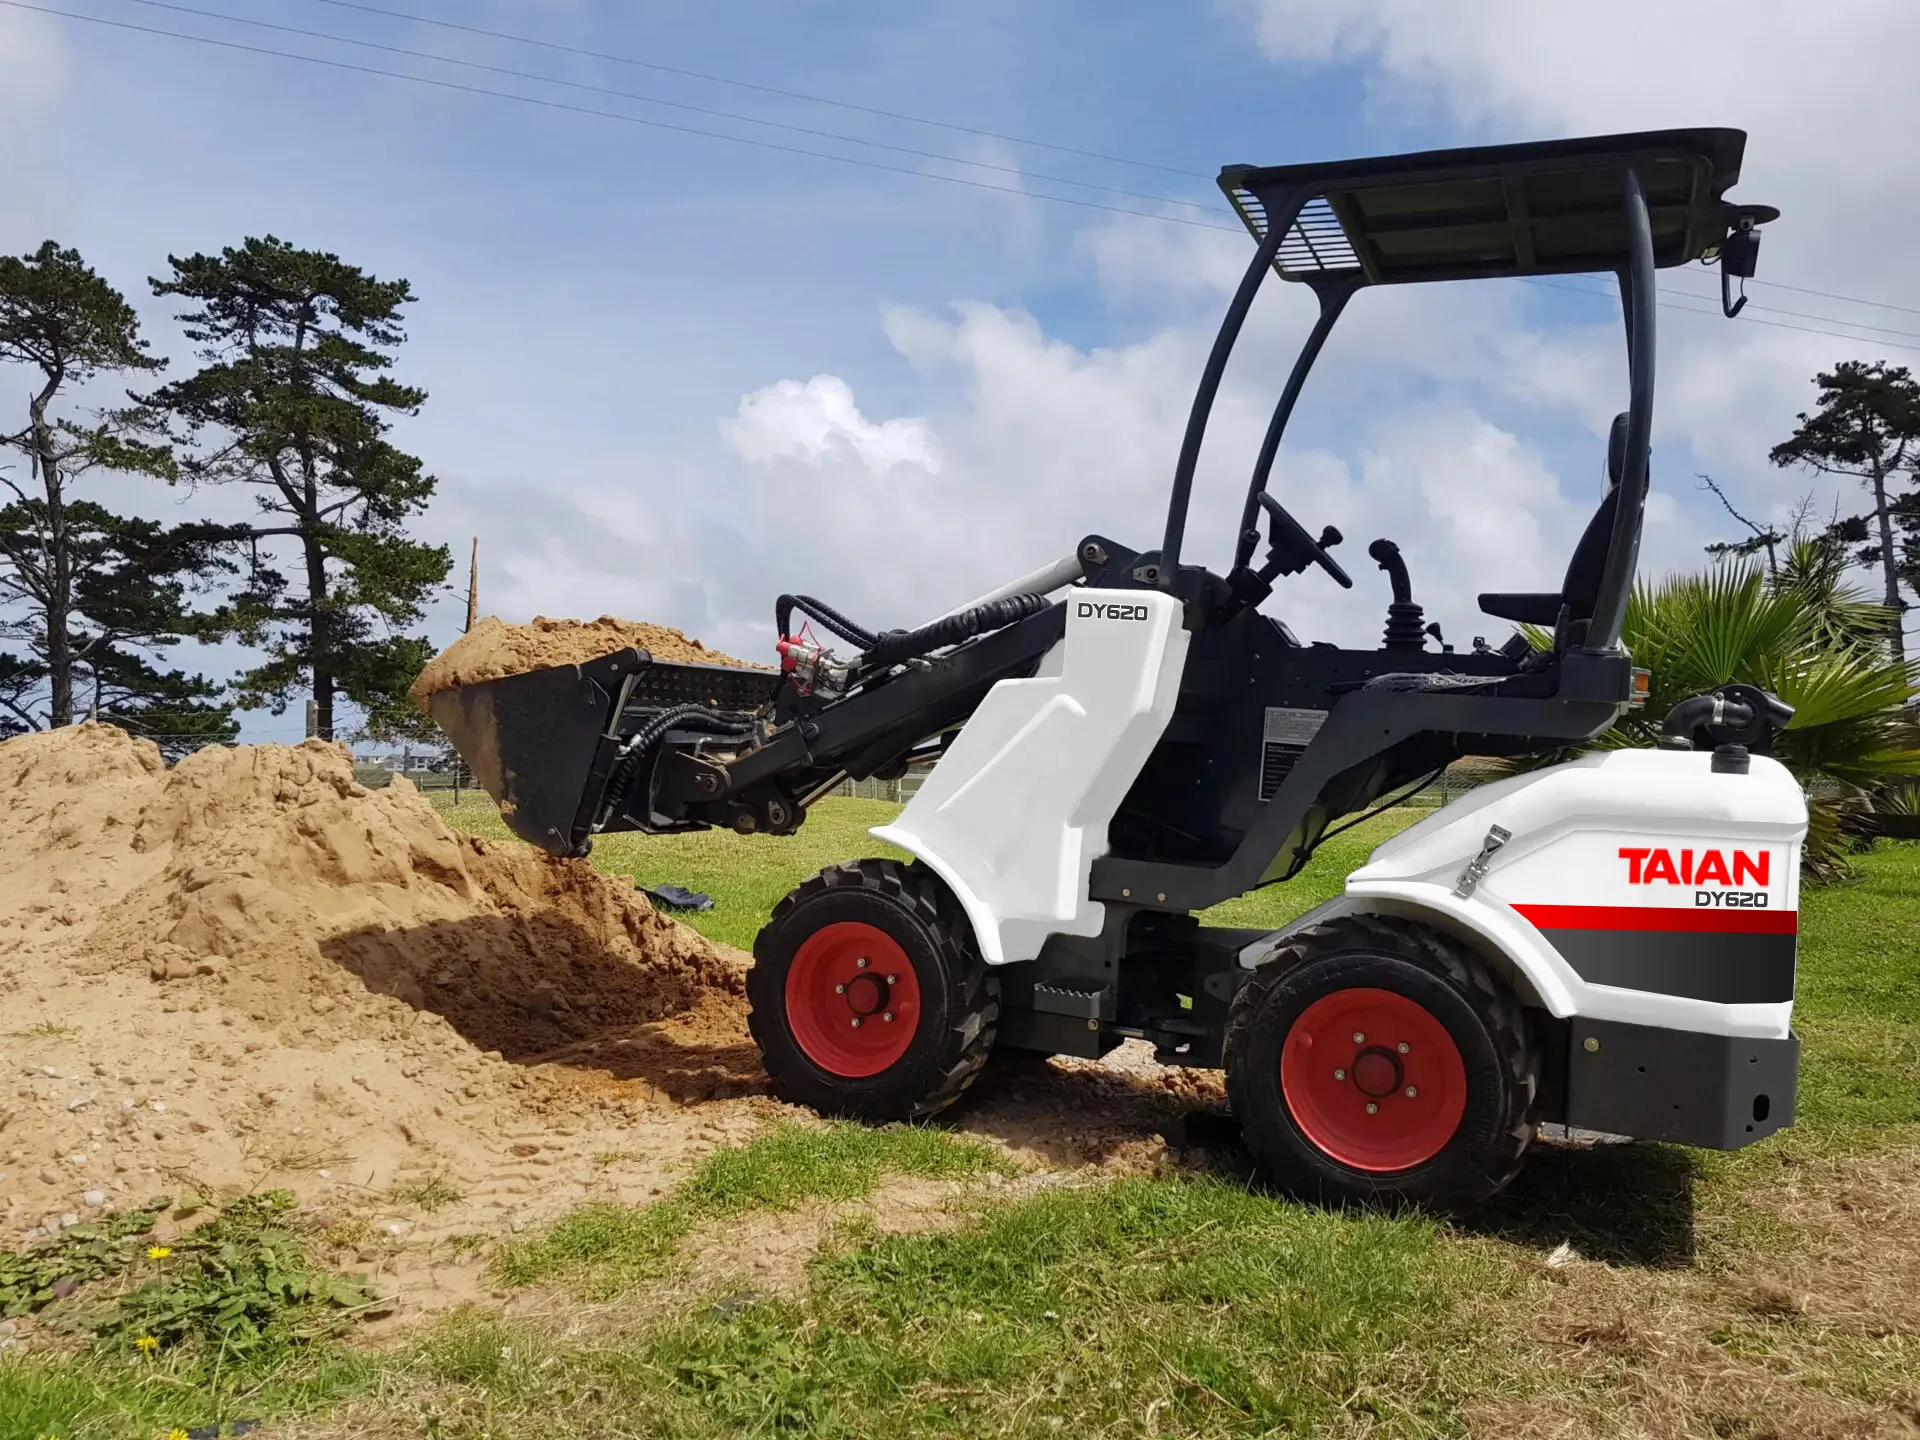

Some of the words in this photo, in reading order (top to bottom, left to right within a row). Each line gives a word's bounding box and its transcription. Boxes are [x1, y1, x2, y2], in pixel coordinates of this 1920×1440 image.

[1077, 602, 1148, 621] DY620
[1618, 847, 1770, 887] TAIAN
[1695, 891, 1768, 908] DY620
